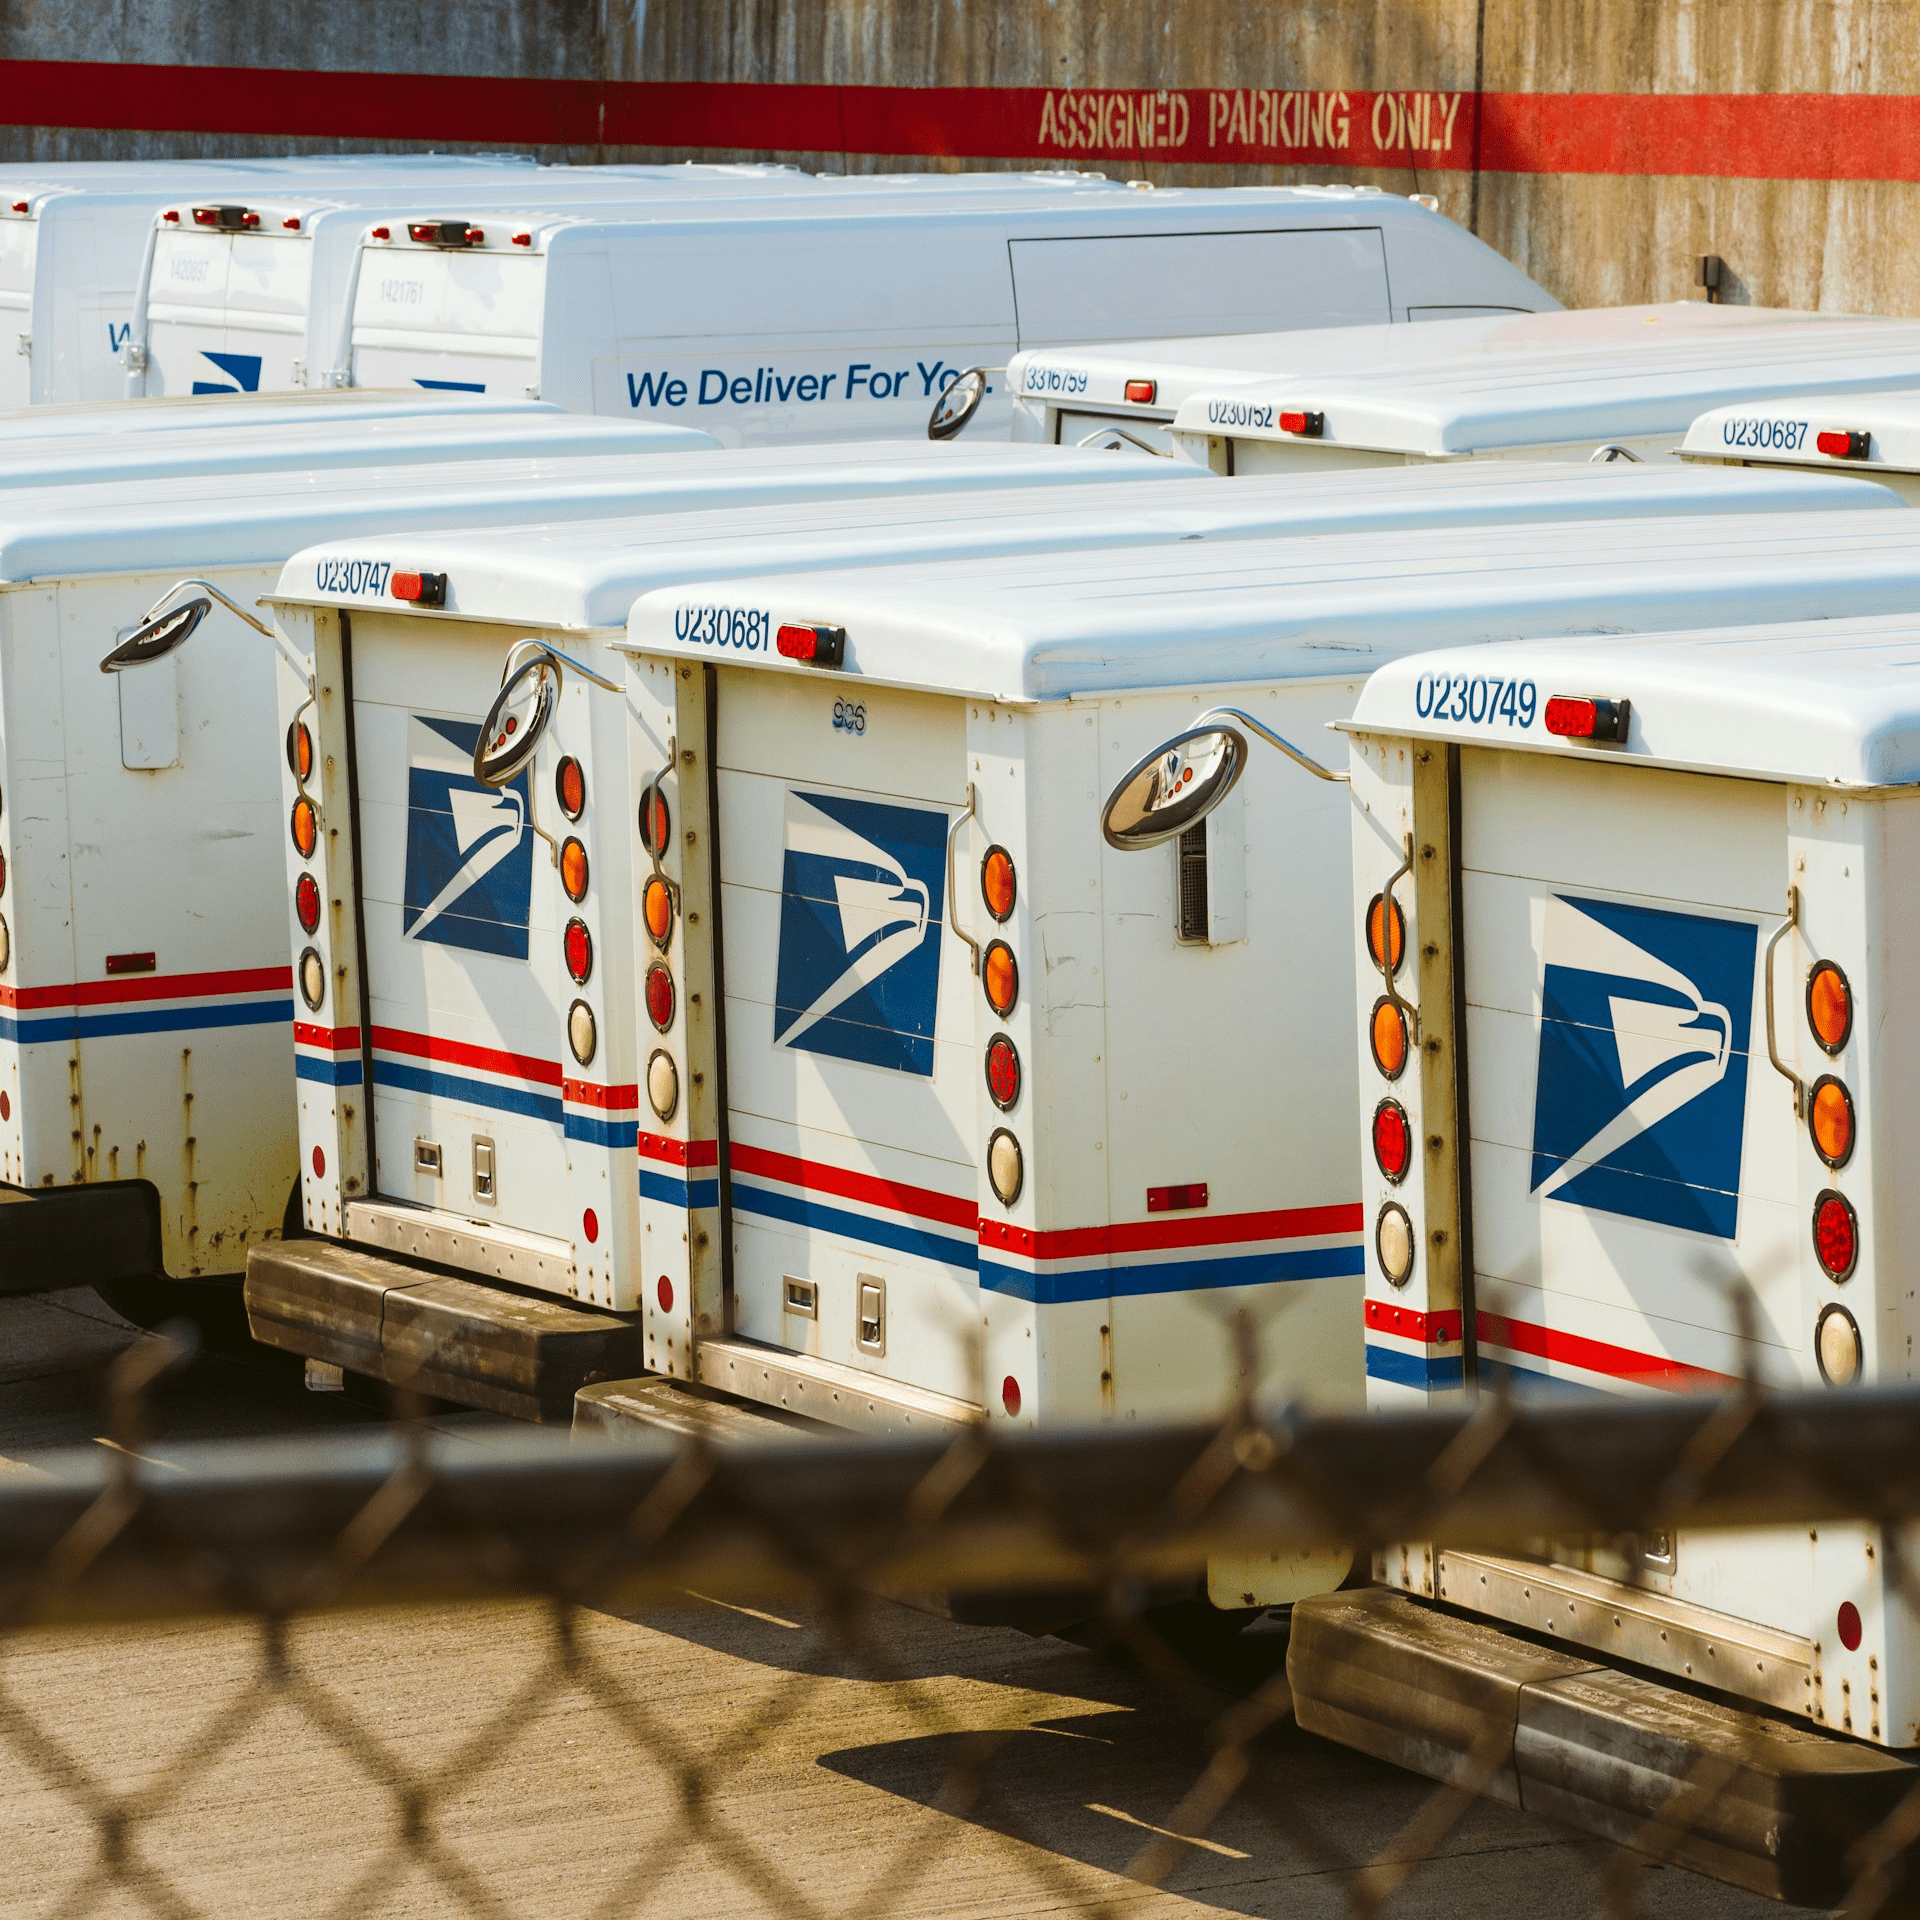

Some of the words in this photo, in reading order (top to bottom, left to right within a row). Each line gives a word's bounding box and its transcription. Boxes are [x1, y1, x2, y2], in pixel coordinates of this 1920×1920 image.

[1038, 90, 1190, 148] ASSIGNED
[1209, 89, 1350, 149] PARKING
[1371, 92, 1462, 151] ONLY
[381, 279, 424, 304] 1421761
[627, 372, 688, 407] We
[698, 368, 836, 405] Deliver
[846, 364, 909, 400] For
[1026, 366, 1088, 393] 3316759
[1723, 418, 1809, 450] 0230687
[317, 557, 391, 597] 0230747
[675, 602, 770, 651] 0230681
[1416, 670, 1536, 728] 0230749
